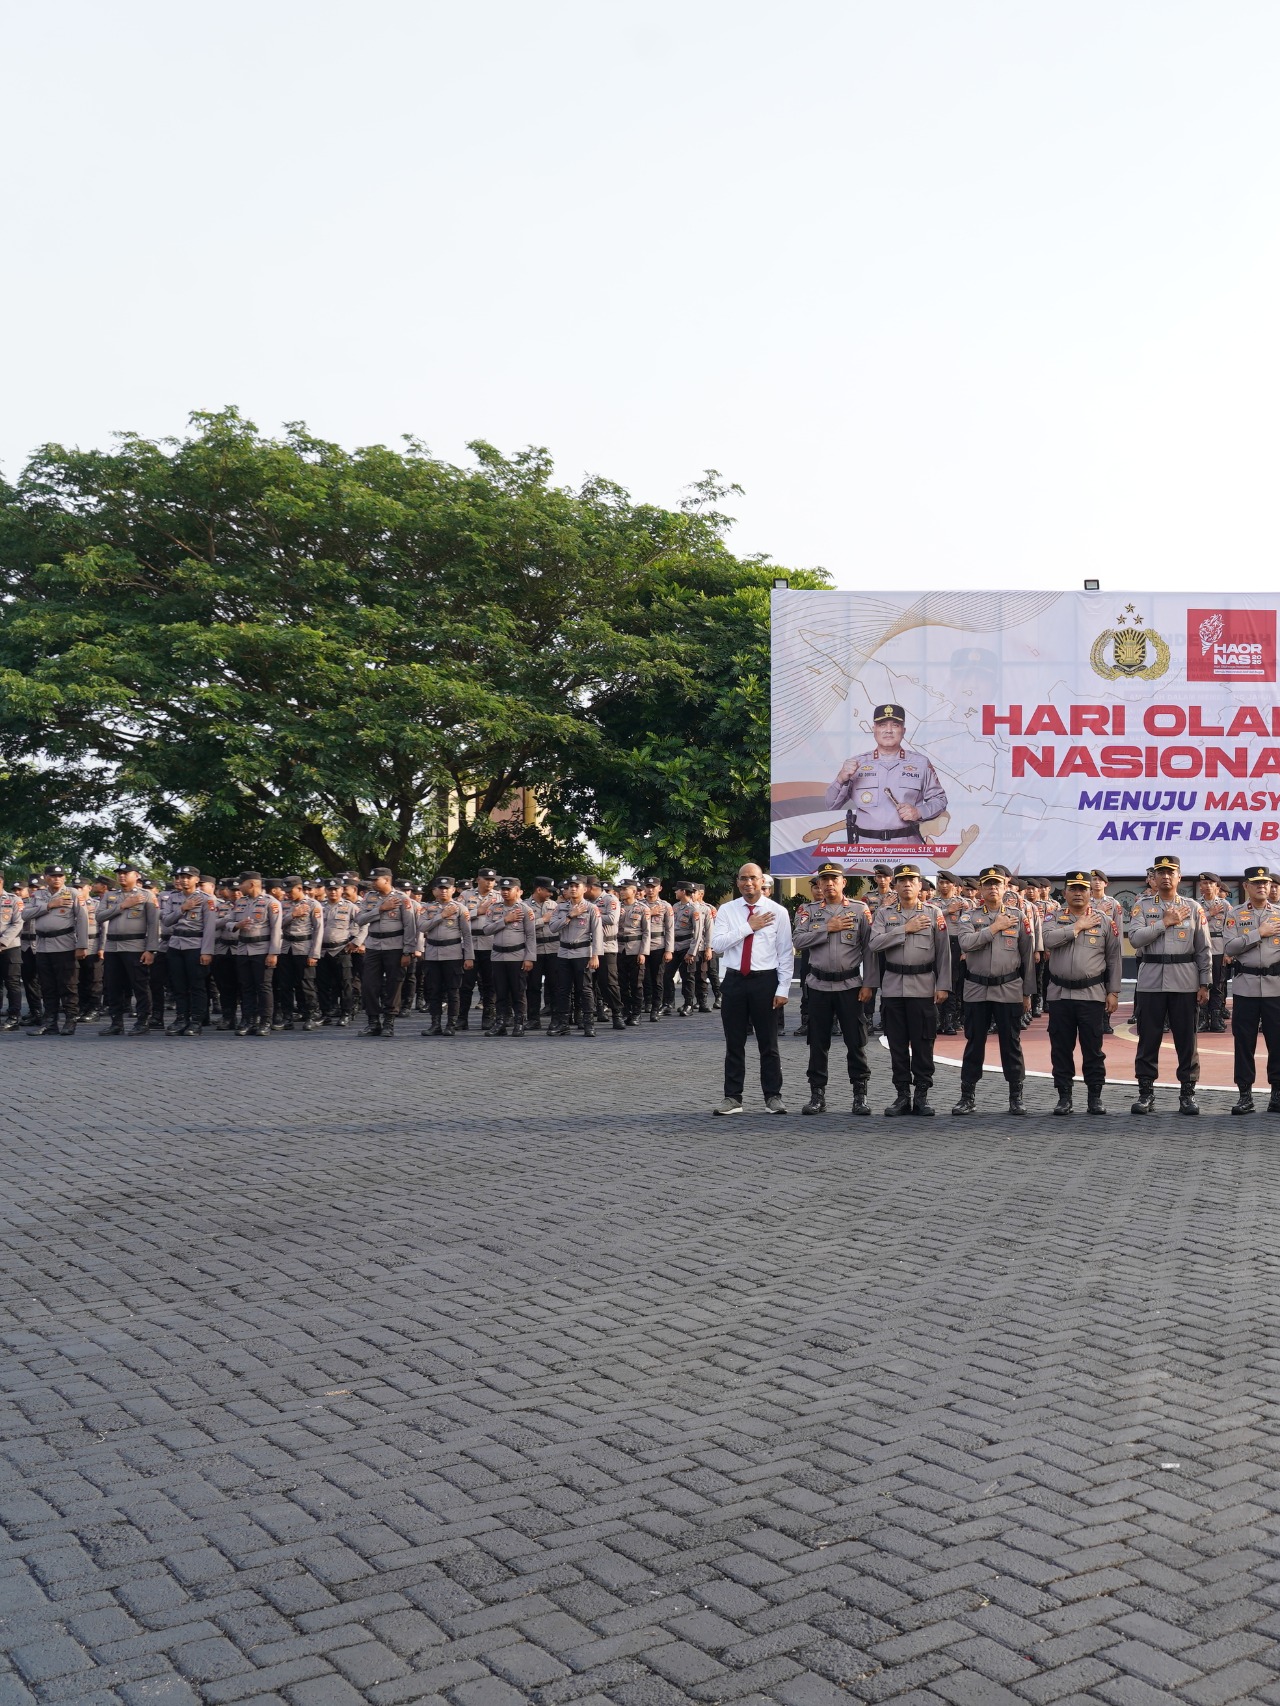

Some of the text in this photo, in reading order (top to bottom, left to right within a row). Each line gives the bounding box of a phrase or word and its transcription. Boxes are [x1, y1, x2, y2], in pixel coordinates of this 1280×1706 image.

[1213, 643, 1262, 654] HAOR
[1213, 654, 1251, 665] NAS
[982, 704, 1125, 736] HARI
[1078, 790, 1196, 811] MENUJU
[1097, 821, 1183, 841] AKTIF
[1188, 821, 1252, 842] DAN
[859, 846, 883, 854] Deriyan
